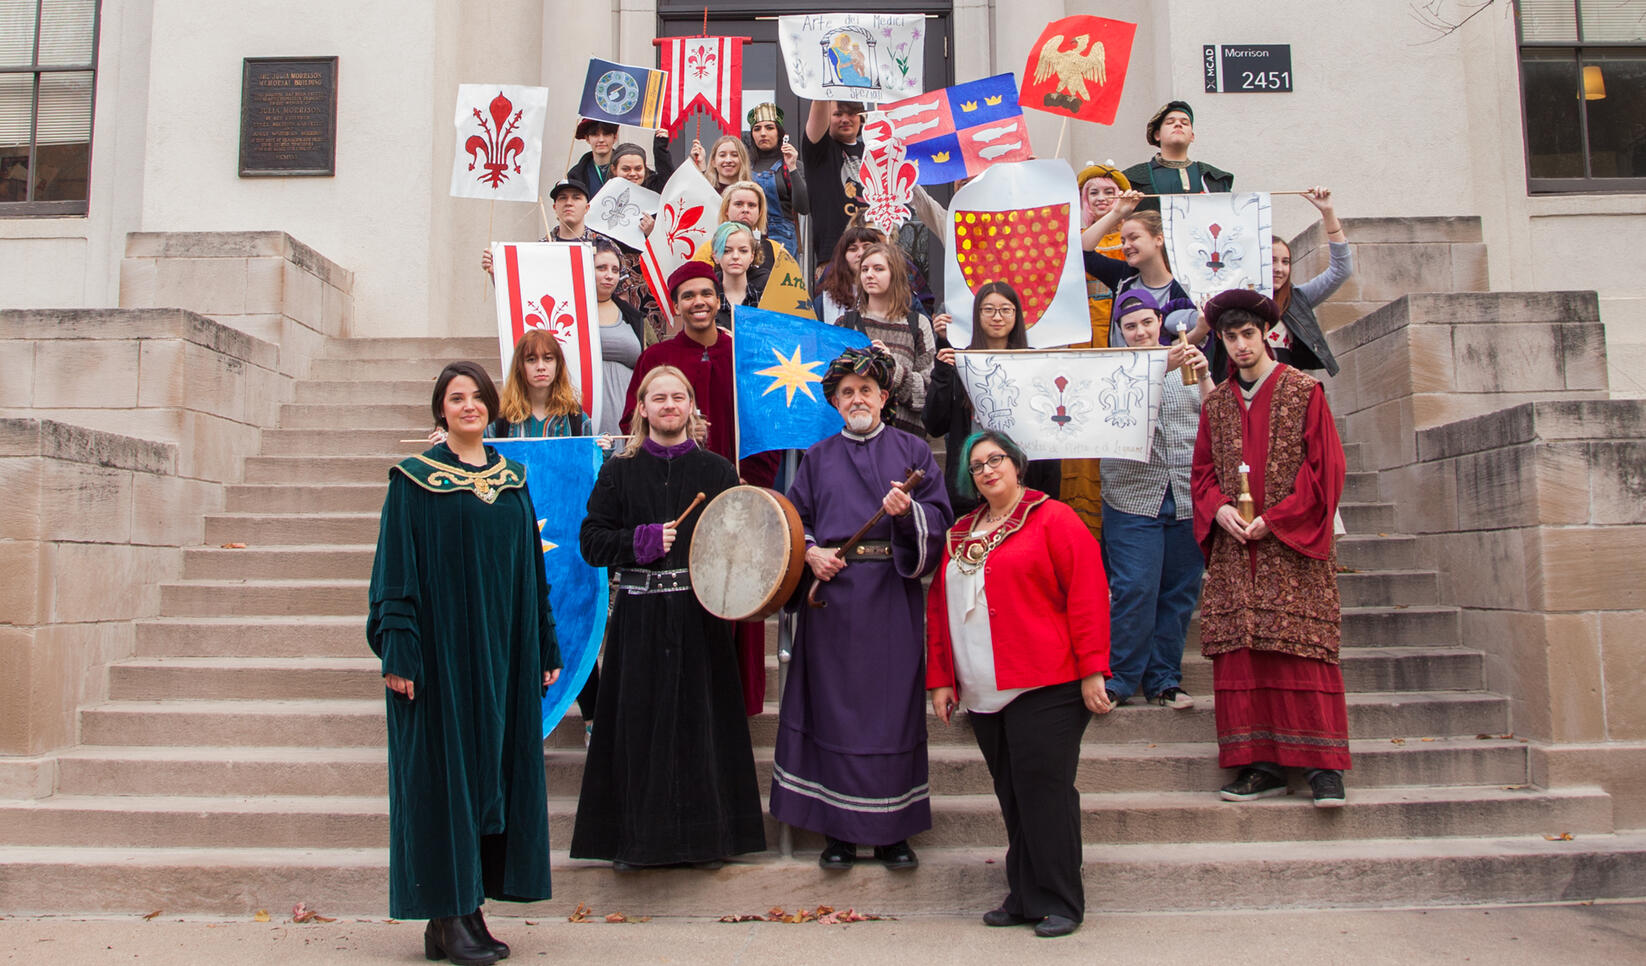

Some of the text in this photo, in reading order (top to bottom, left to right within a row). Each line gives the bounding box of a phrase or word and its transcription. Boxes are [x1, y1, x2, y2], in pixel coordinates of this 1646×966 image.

[802, 14, 905, 31] Arte dei Medici
[1224, 48, 1269, 57] Morrison
[1205, 48, 1215, 77] MCAD
[1241, 71, 1290, 89] 2451
